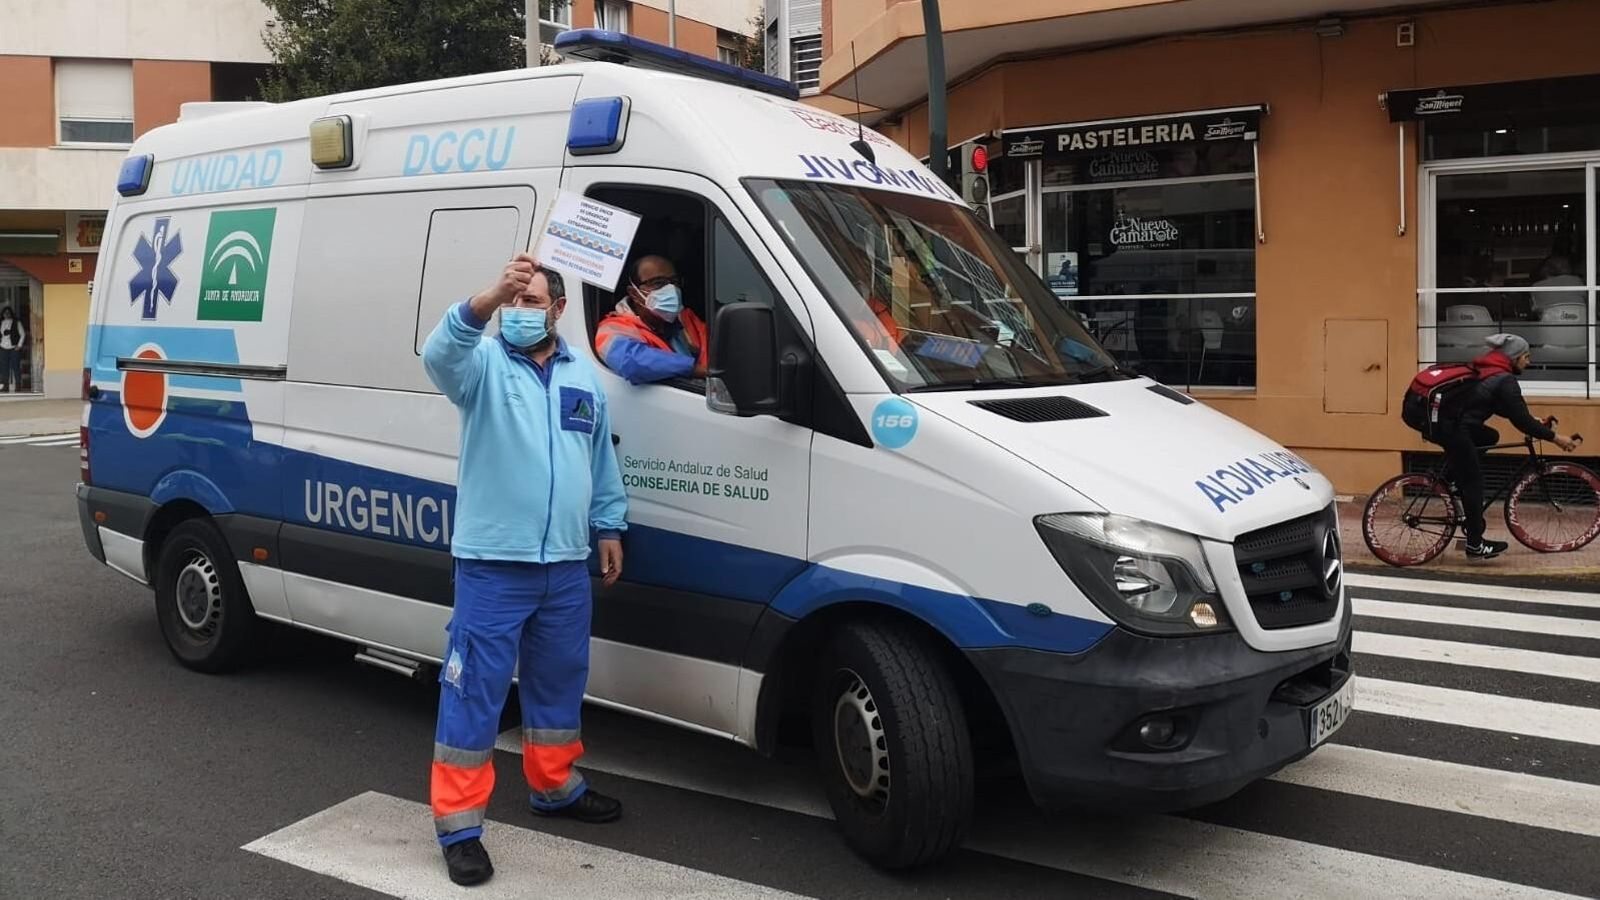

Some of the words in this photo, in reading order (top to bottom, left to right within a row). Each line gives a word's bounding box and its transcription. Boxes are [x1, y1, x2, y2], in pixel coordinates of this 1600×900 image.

[1057, 122, 1195, 152] PASTELERIA
[402, 125, 515, 177] DCCU
[171, 149, 283, 197] UNIDAD
[1110, 227, 1179, 245] Camarote
[1127, 218, 1168, 231] Nuevo
[203, 289, 220, 301] JUNTA
[221, 290, 229, 302] DE
[876, 414, 914, 428] 156
[624, 455, 666, 471] Servicio
[668, 459, 713, 476] Andaluz
[716, 464, 731, 478] de
[734, 465, 768, 482] Salud
[622, 474, 700, 494] CONSEJERIA
[703, 482, 720, 496] DE
[724, 484, 769, 501] SALUD
[305, 479, 450, 545] URGENCI
